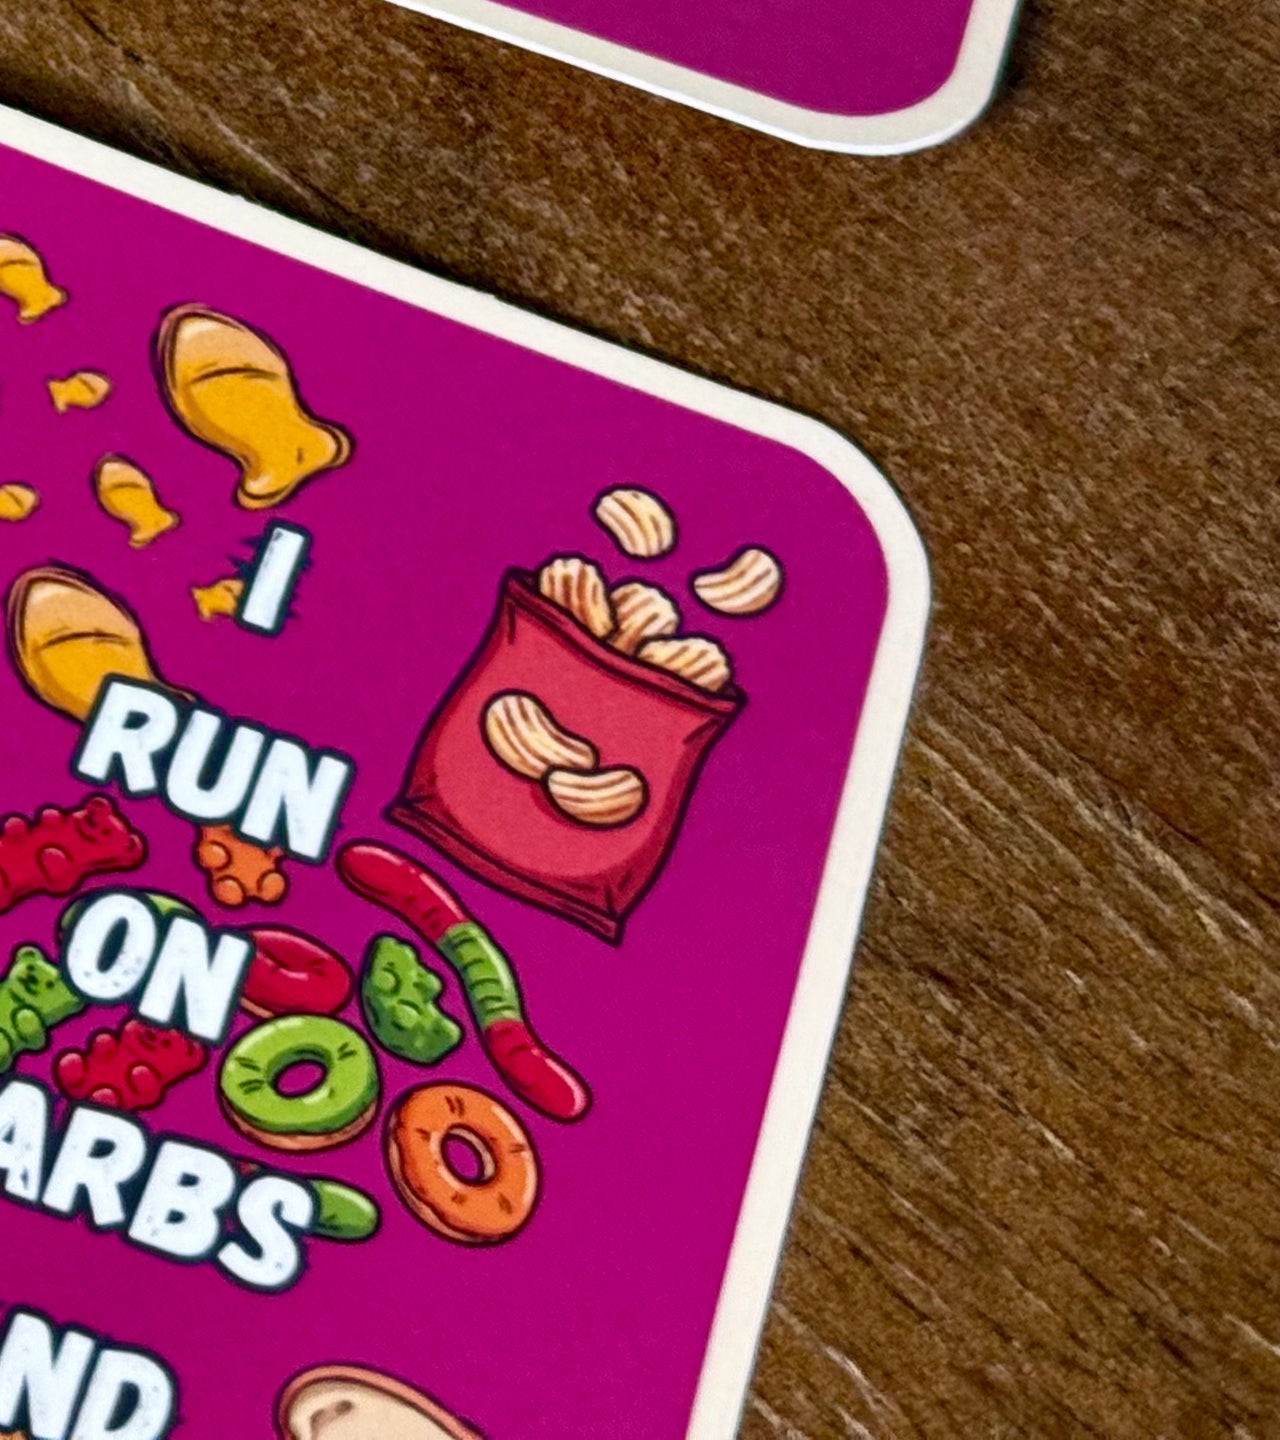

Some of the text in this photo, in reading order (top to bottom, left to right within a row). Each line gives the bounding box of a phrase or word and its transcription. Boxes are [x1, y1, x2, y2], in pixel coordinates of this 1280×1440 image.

[243, 528, 303, 628] I
[79, 683, 347, 857] RUN
[68, 895, 248, 1039] ON
